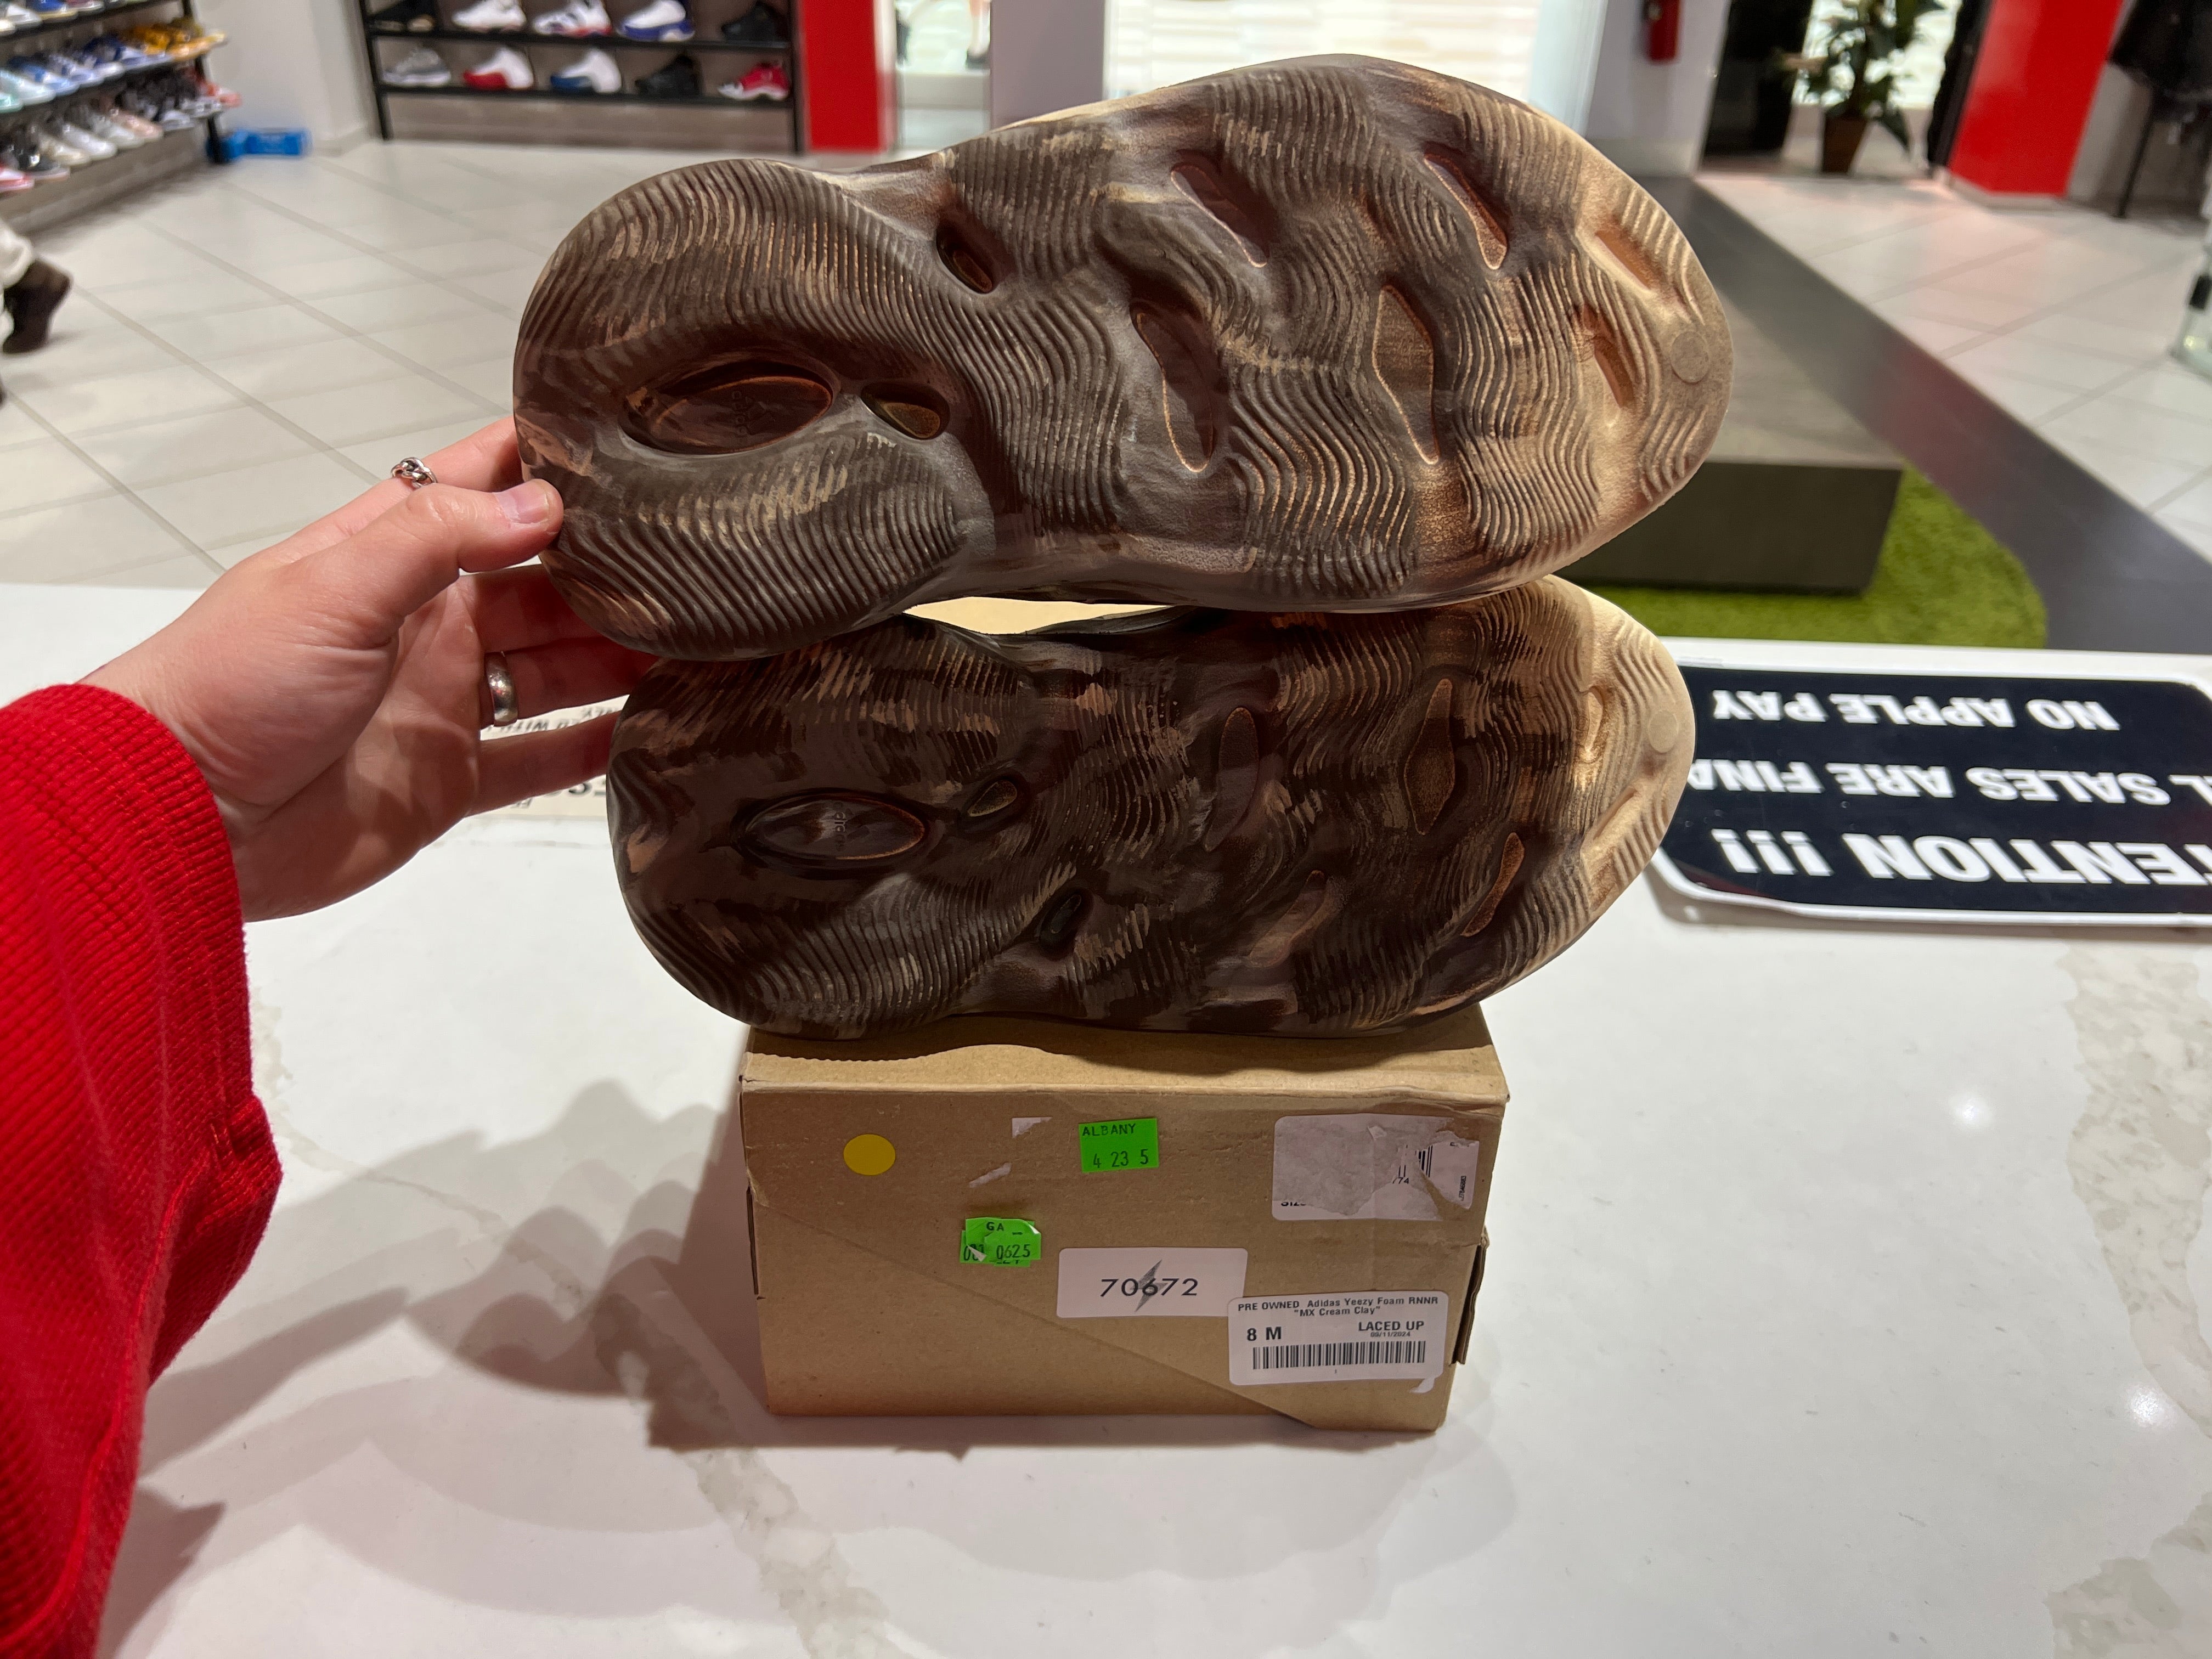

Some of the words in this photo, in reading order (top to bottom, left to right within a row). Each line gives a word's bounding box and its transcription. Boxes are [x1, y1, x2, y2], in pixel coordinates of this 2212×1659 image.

[1712, 690, 1829, 723] PAY
[1828, 693, 2017, 728] APPLE
[2025, 699, 2121, 730] NO
[1686, 759, 1825, 793] FINA
[1825, 763, 1956, 798] ARE
[1966, 766, 2171, 805] SALES
[1711, 828, 1835, 877] !!!
[1082, 1123, 1136, 1136] ALBANY
[1100, 1278, 1198, 1296] 70672
[1238, 1303, 1257, 1311] PRE
[1262, 1301, 1300, 1310] OWNED
[1307, 1299, 1340, 1307] Adidas
[1345, 1298, 1373, 1306] Yeezy
[1319, 1308, 1350, 1316] Cream
[1354, 1306, 1380, 1314] Clay"
[1247, 1328, 1257, 1341] 8
[1266, 1327, 1282, 1340] M
[1358, 1321, 1401, 1331] LACED
[1406, 1321, 1424, 1330] UP
